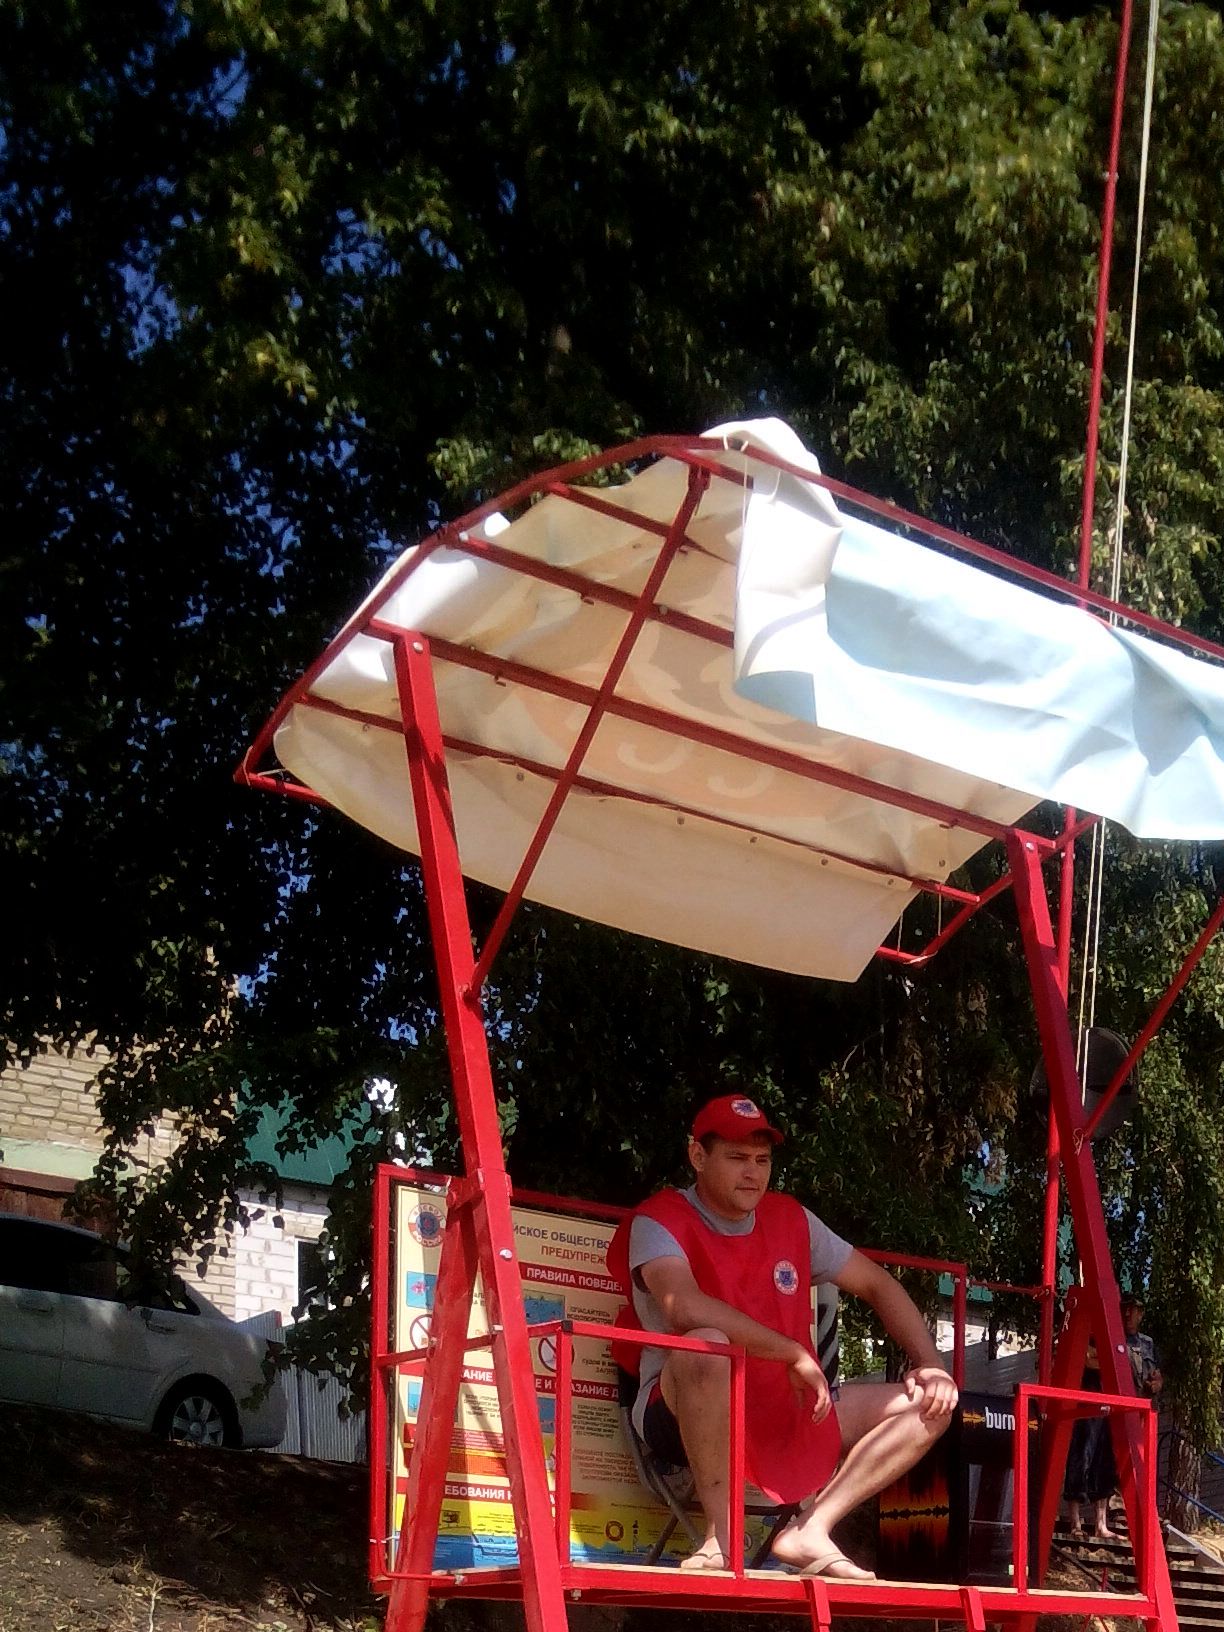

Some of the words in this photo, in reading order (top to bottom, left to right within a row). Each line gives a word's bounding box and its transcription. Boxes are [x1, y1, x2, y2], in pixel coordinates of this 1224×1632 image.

[526, 1267, 576, 1284] ПРАВИЛА
[578, 1275, 622, 1292] ПОВЕДЕ
[984, 1405, 1016, 1431] burn
